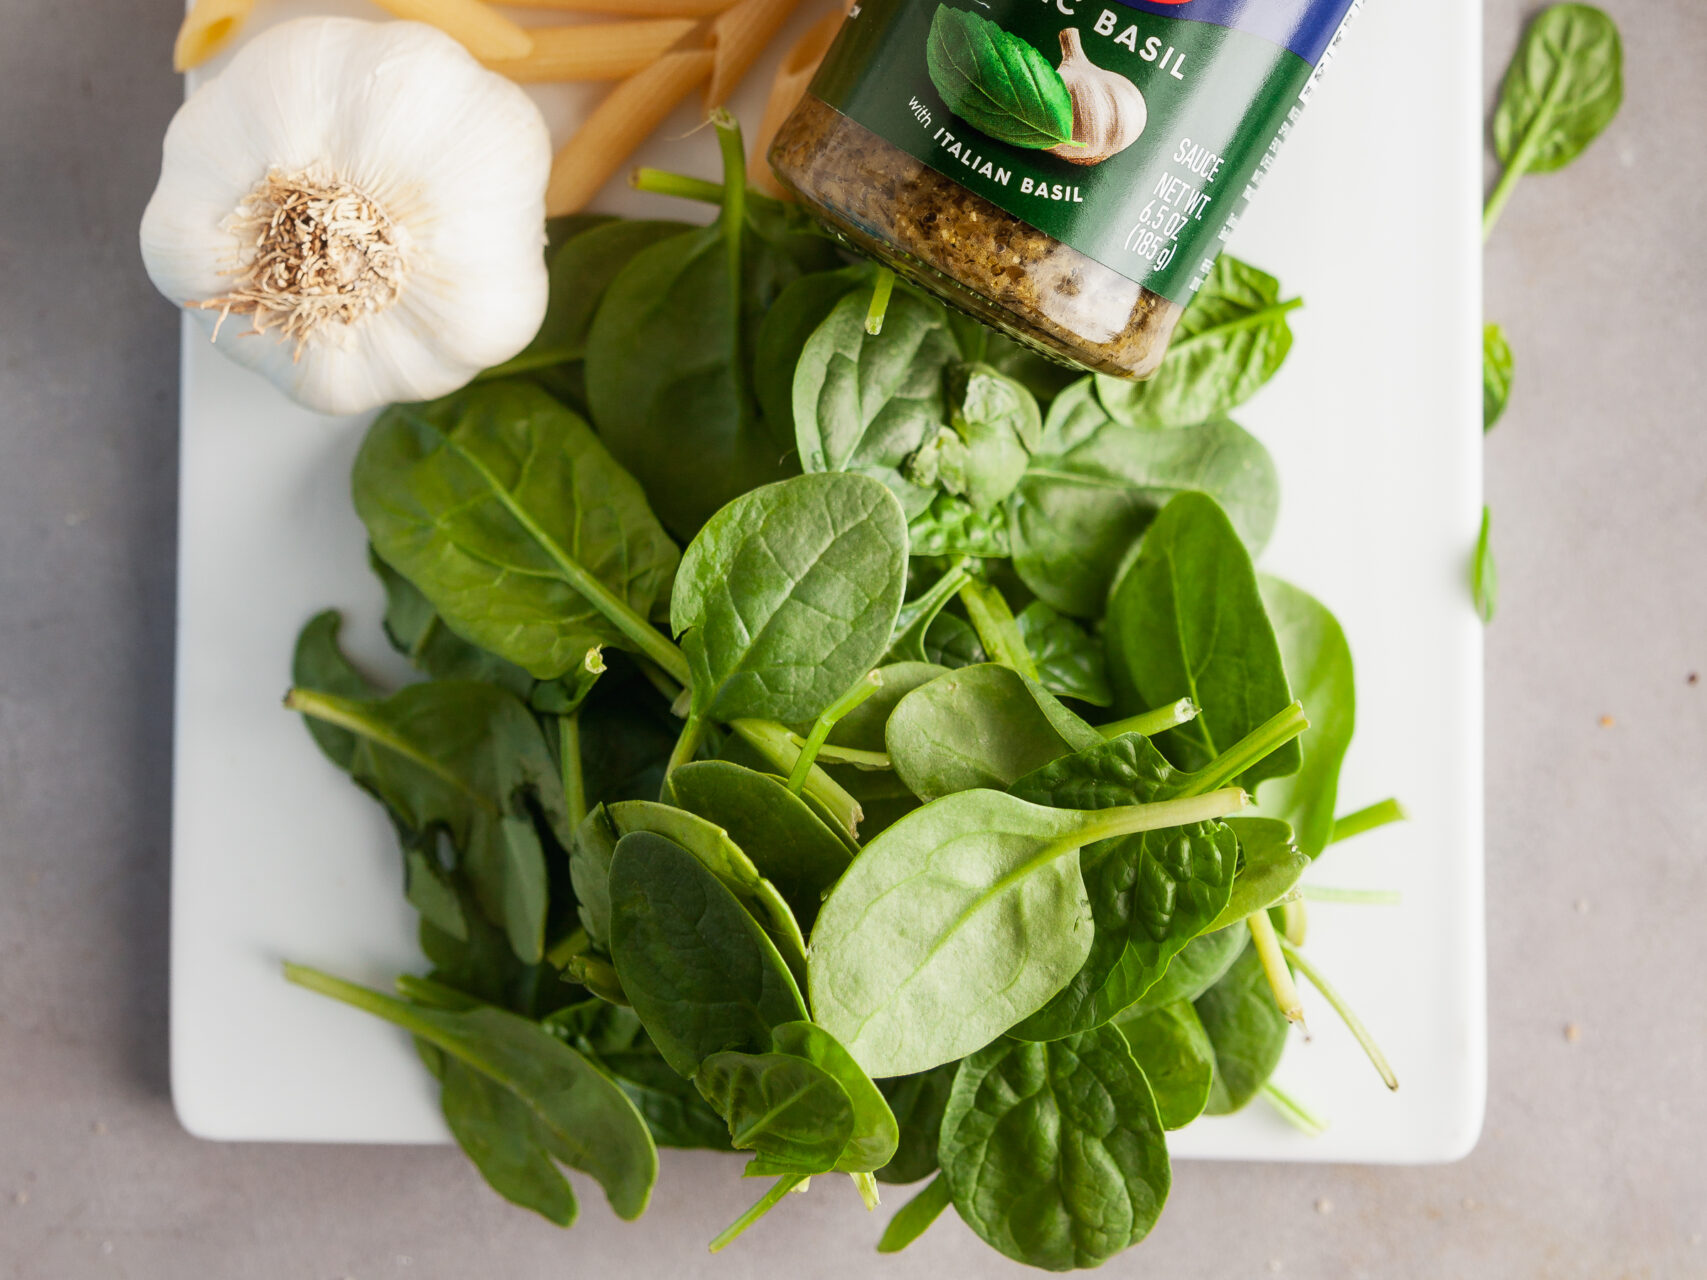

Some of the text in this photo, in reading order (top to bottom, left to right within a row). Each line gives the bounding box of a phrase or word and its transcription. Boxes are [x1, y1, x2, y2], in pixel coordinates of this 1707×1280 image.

[1093, 8, 1187, 80] BASIL
[908, 95, 1084, 203] with ITALIAN BASIL
[1173, 137, 1225, 183] SAUCE
[1138, 199, 1170, 230] 6.5
[1163, 212, 1189, 241] OZ
[1153, 171, 1212, 221] NET WT.
[1124, 222, 1178, 272] (185 g)
